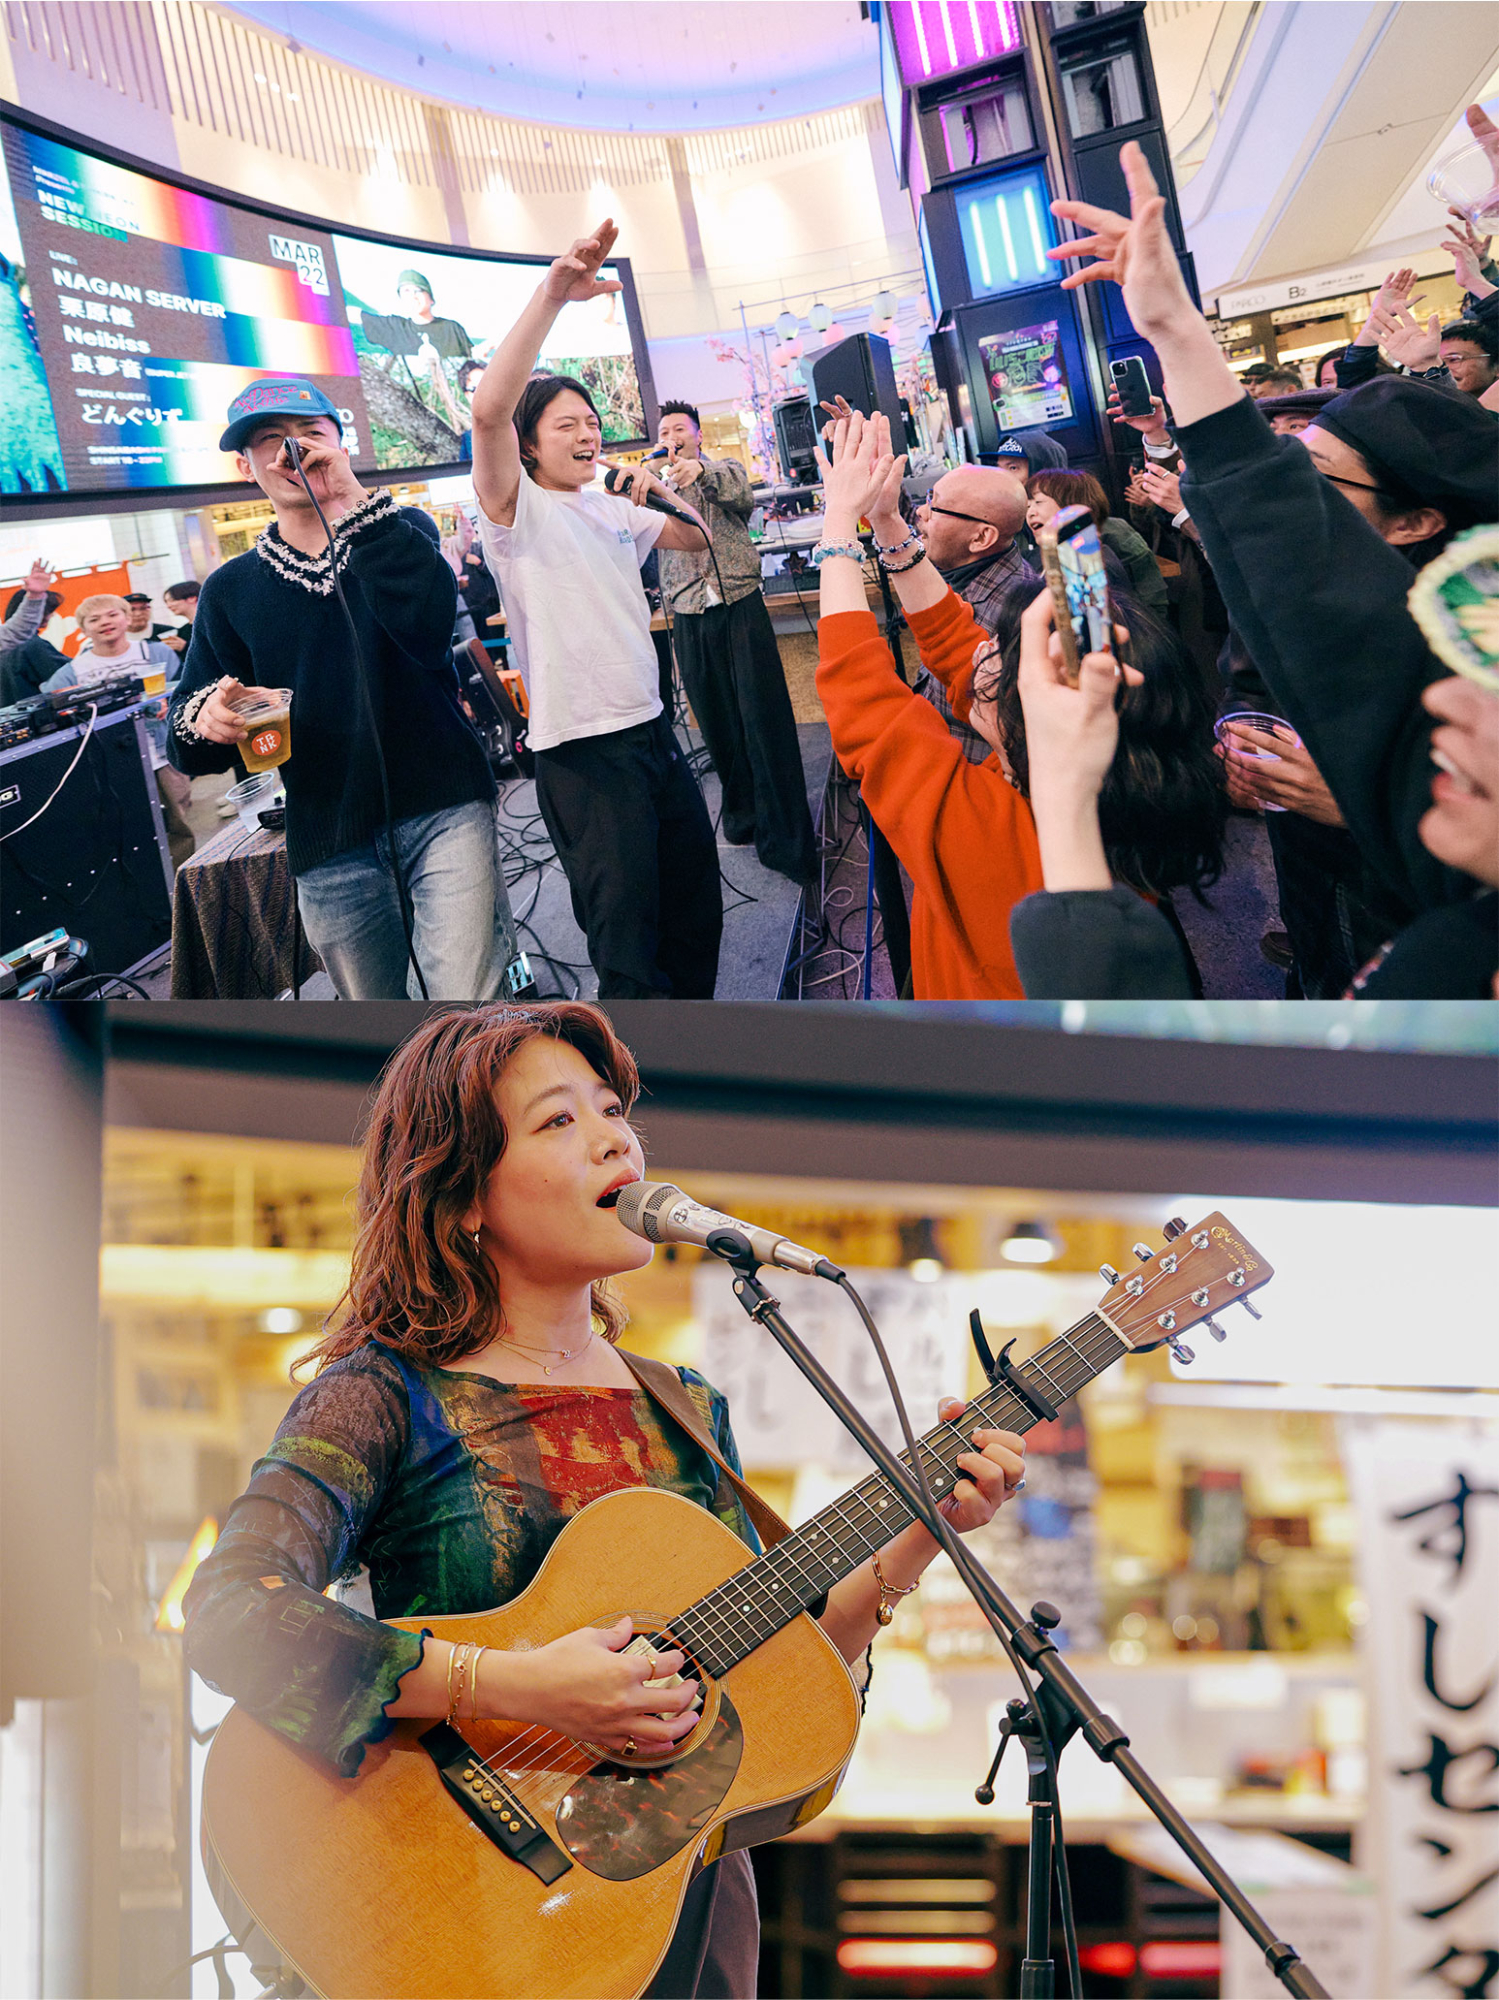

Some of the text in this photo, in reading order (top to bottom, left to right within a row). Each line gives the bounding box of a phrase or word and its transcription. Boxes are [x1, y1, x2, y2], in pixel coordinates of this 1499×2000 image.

[37, 189, 85, 215] NEW
[40, 205, 129, 243] SESSION
[273, 238, 321, 265] MAR
[300, 265, 325, 286] 22
[51, 267, 227, 320] NAGAN SERVER
[62, 324, 151, 354] Neibiss
